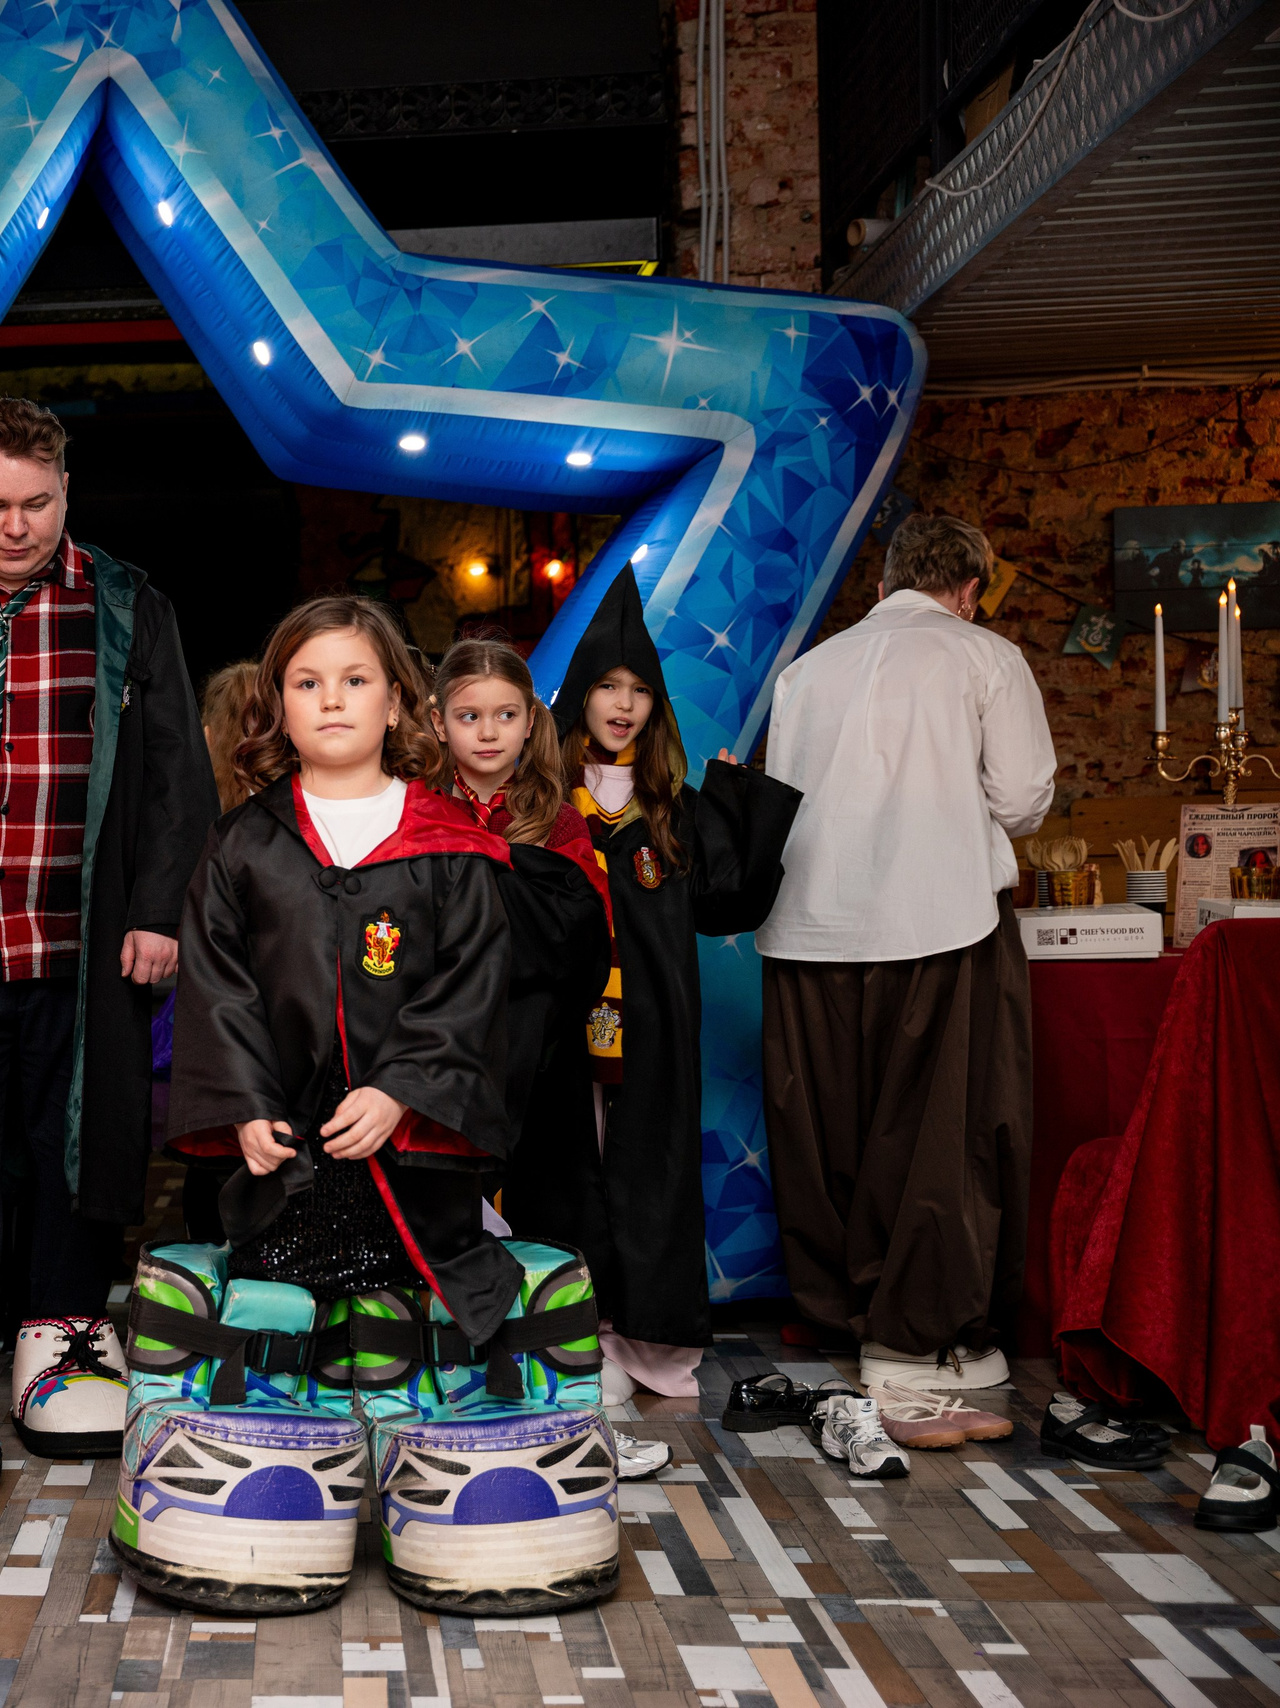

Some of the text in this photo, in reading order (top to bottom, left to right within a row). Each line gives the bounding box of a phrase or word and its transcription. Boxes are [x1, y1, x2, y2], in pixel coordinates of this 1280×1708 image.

[1189, 812, 1278, 821] ЕЖЕДНЕВНЫЙ ПРОРОК
[1080, 927, 1105, 935] CHEF'S
